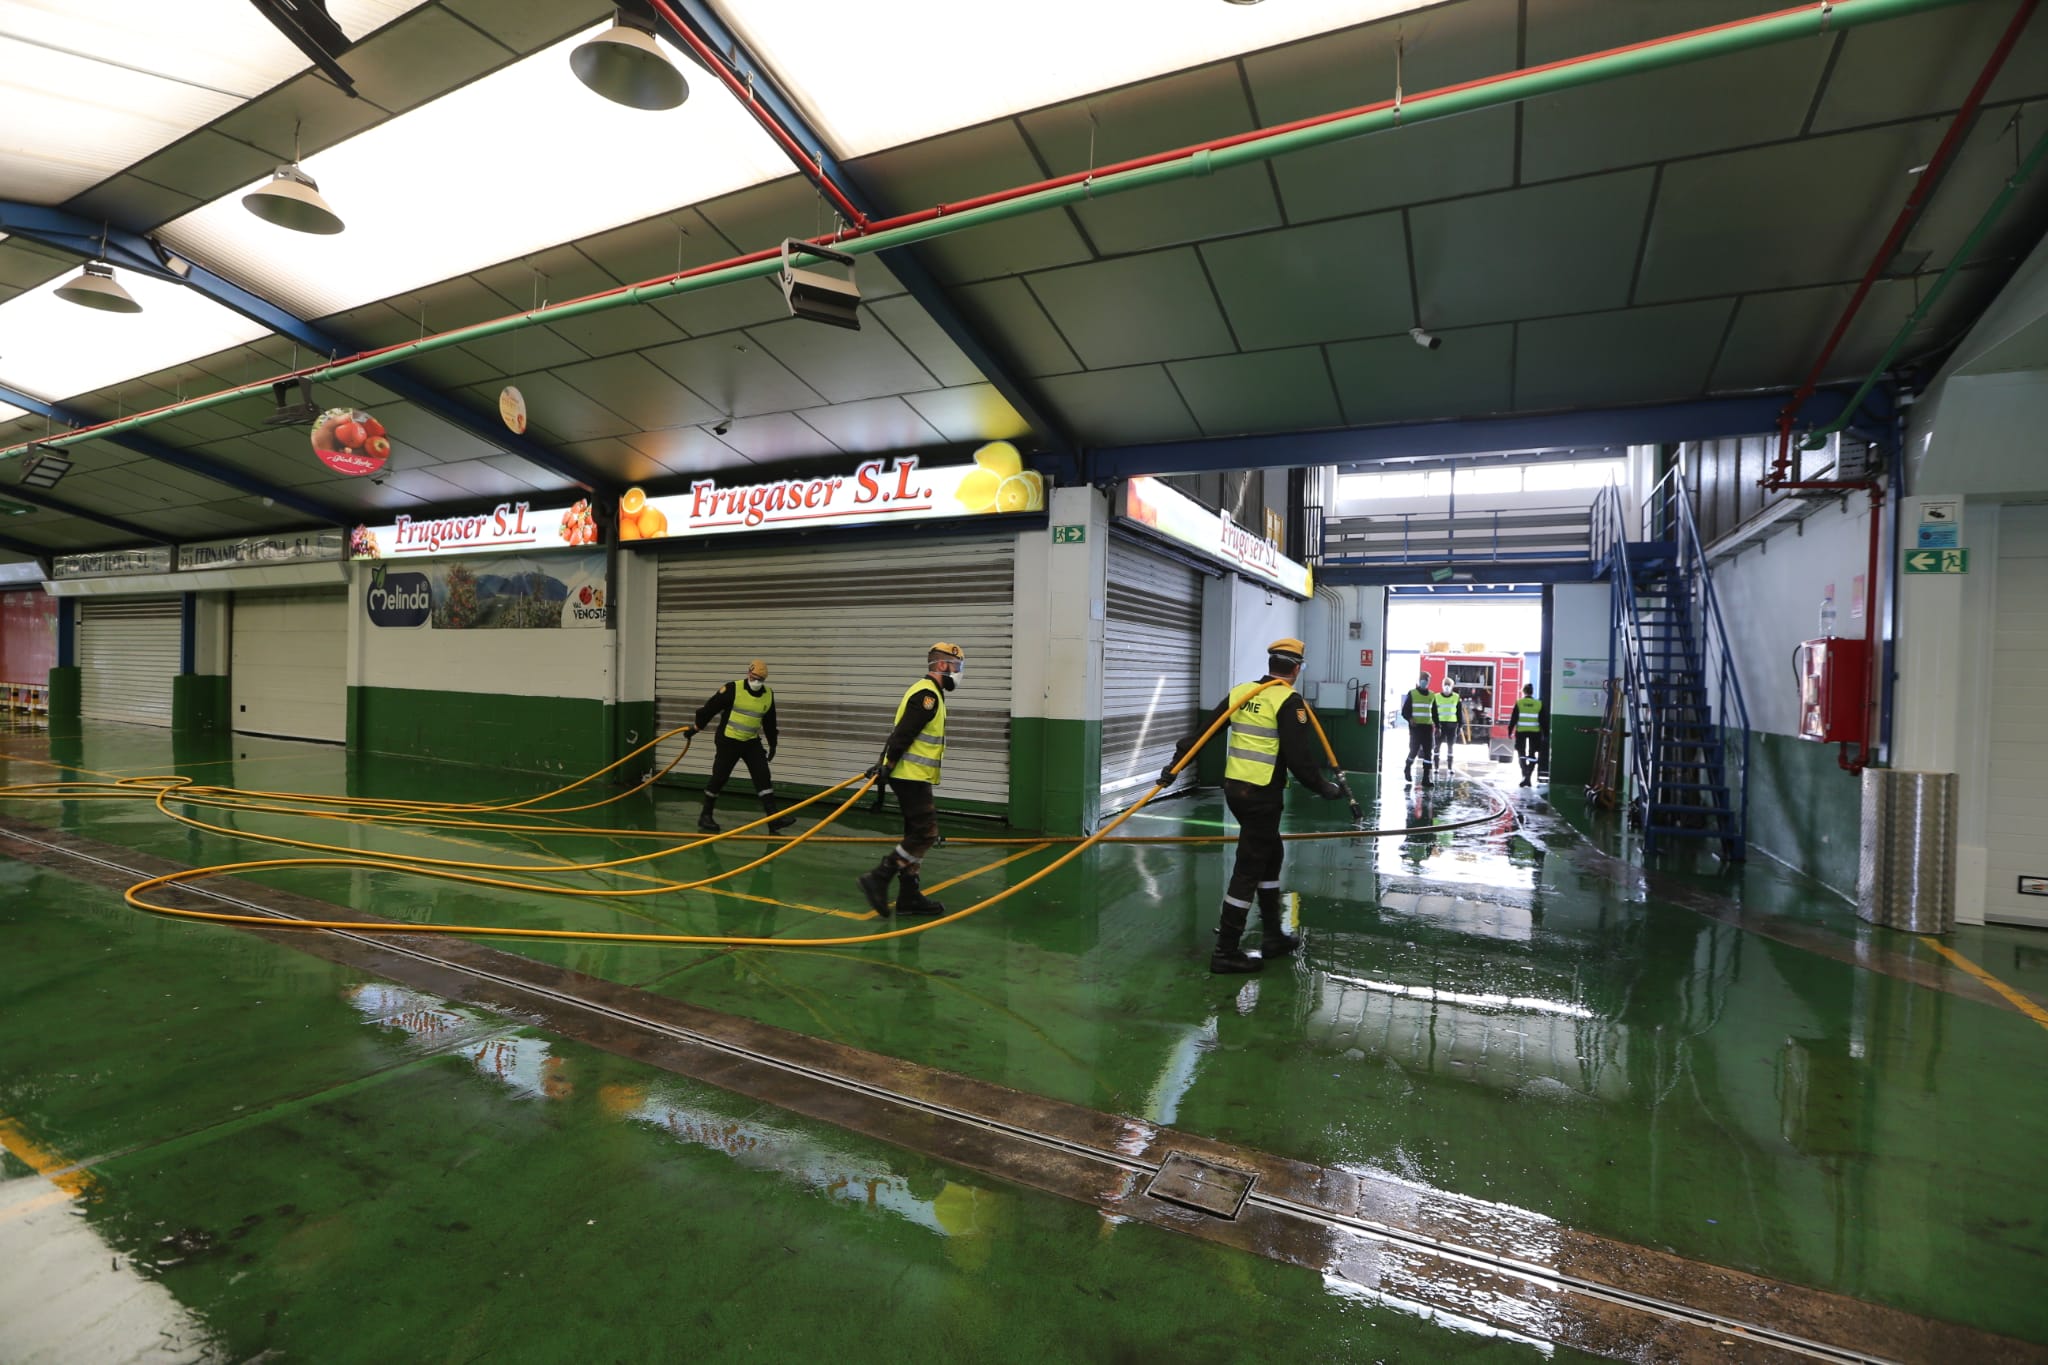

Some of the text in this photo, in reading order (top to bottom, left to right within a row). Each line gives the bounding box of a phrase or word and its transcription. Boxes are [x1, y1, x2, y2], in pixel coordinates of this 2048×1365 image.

[690, 461, 932, 527] Frugaser S.L.
[395, 503, 537, 551] Frugaser S.L.
[1221, 514, 1264, 563] Frugaser
[370, 583, 429, 610] Melinda
